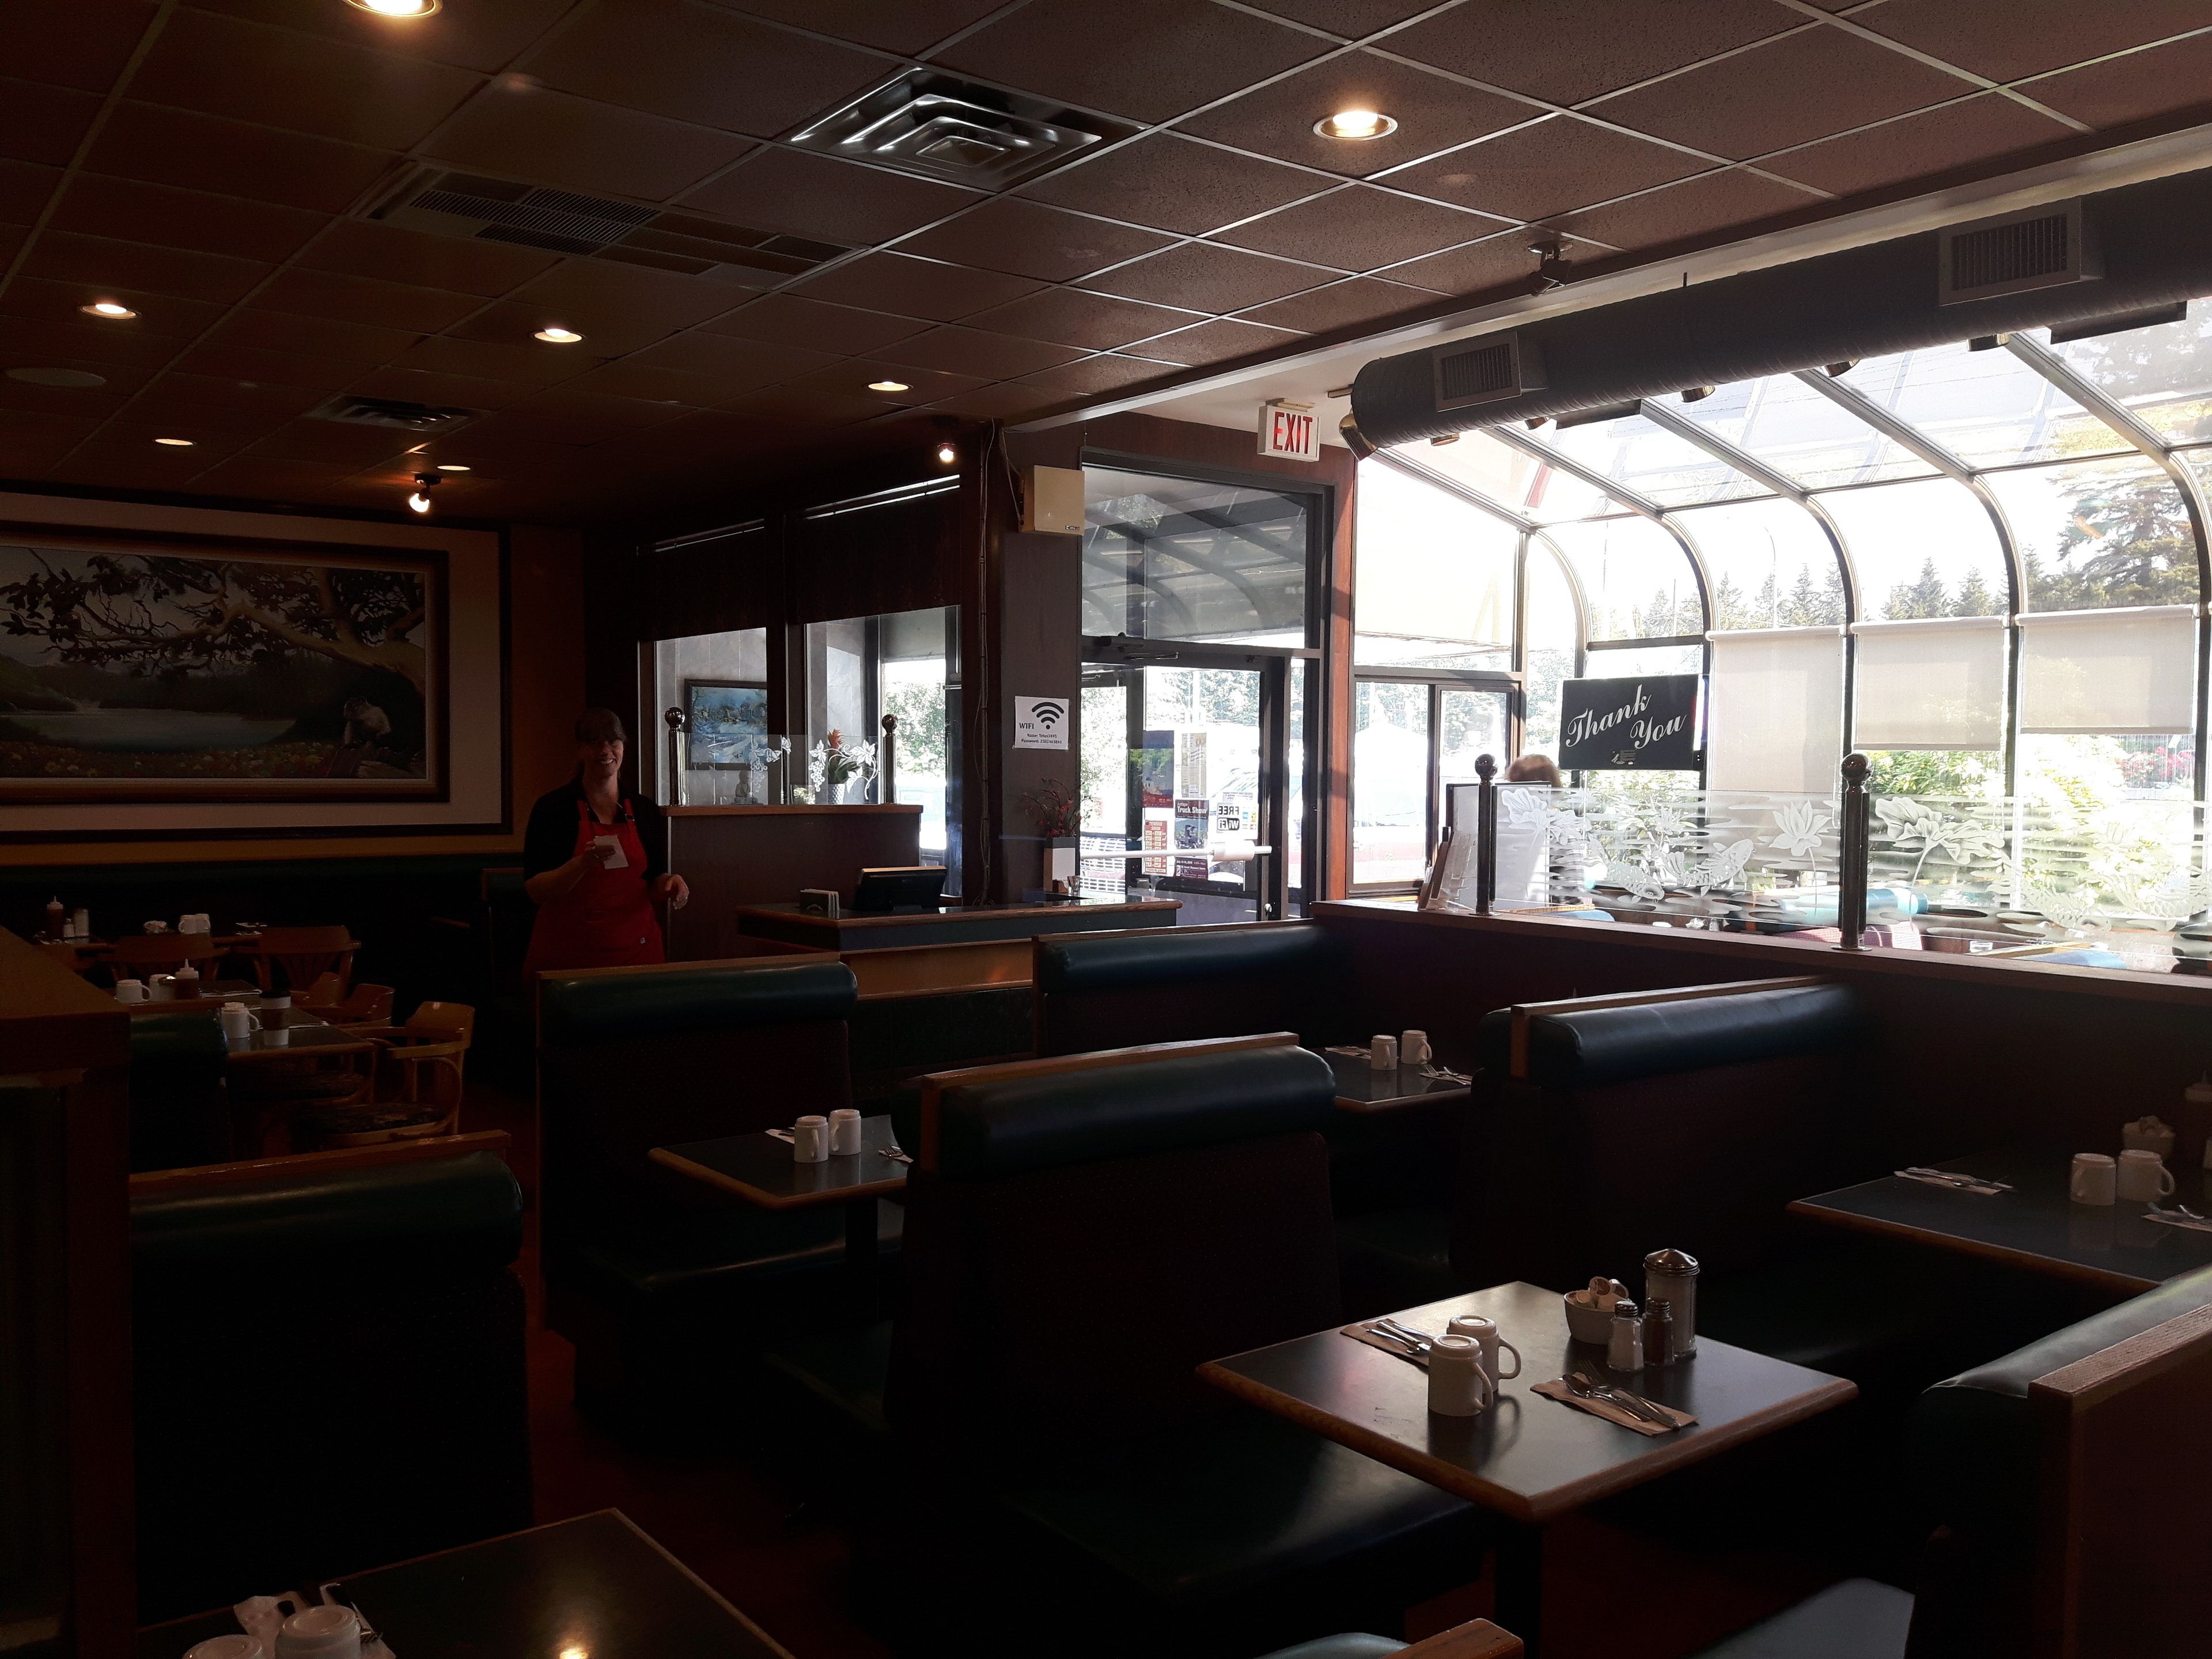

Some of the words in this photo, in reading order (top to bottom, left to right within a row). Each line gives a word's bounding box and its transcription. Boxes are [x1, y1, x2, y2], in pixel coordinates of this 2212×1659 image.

[1272, 411, 1313, 454] EXIT
[1565, 683, 1652, 748] Thank
[1630, 714, 1687, 749] You
